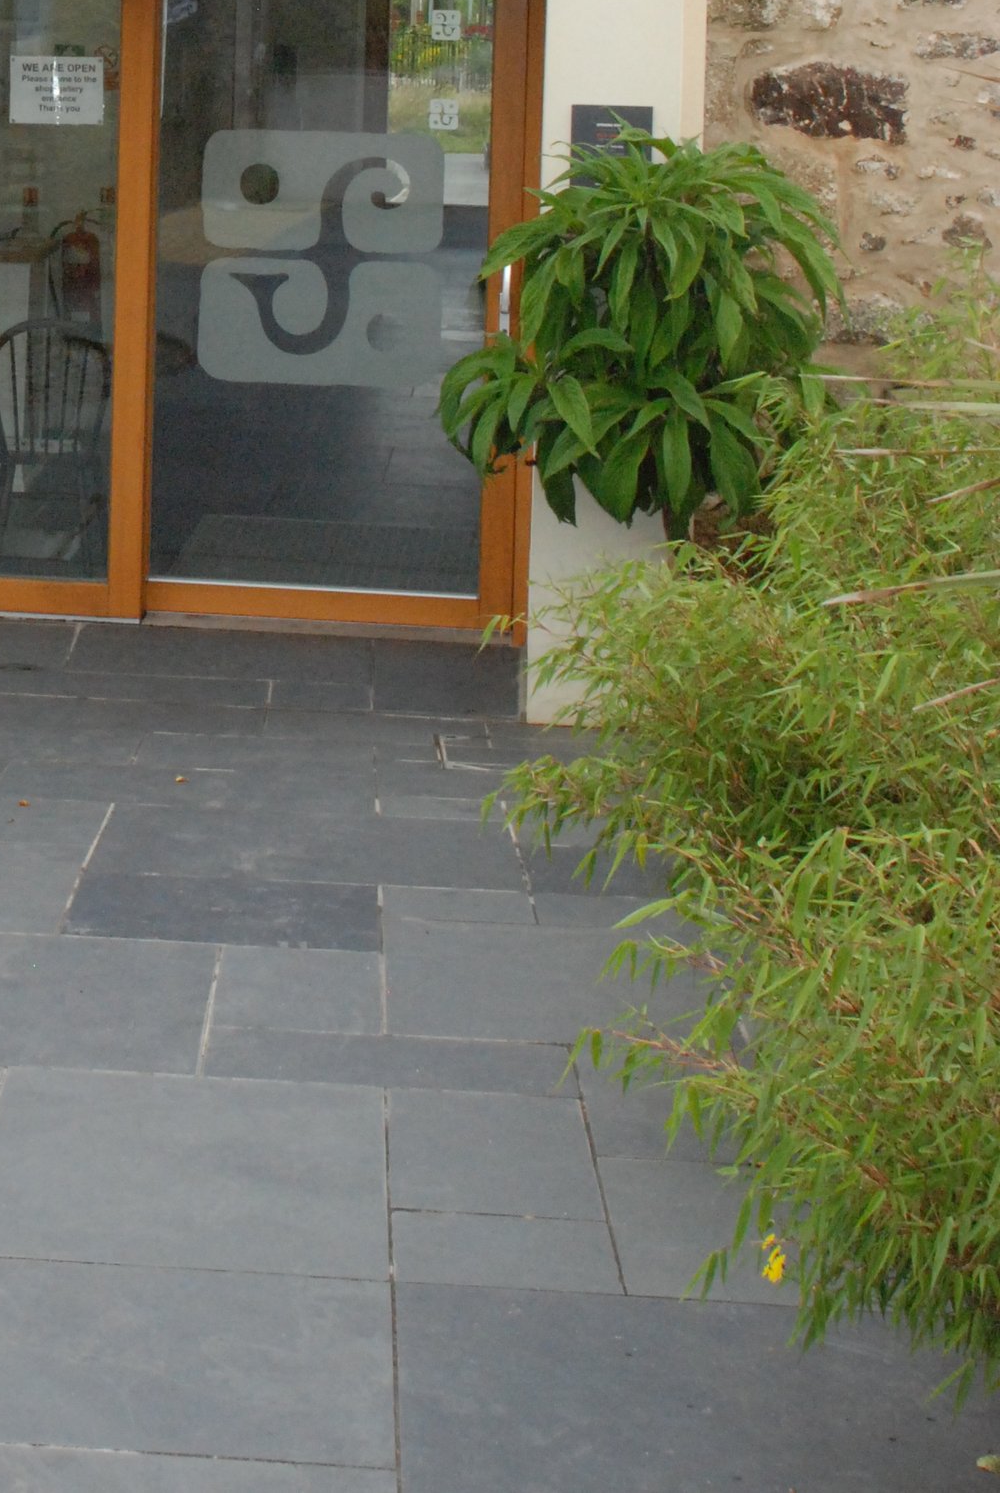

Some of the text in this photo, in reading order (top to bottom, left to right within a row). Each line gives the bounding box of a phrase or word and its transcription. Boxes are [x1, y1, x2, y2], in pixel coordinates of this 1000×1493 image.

[22, 63, 96, 73] WE ARE OPEN
[22, 74, 48, 83] Please
[74, 75, 82, 83] to
[84, 75, 97, 83] the
[65, 105, 81, 113] you
